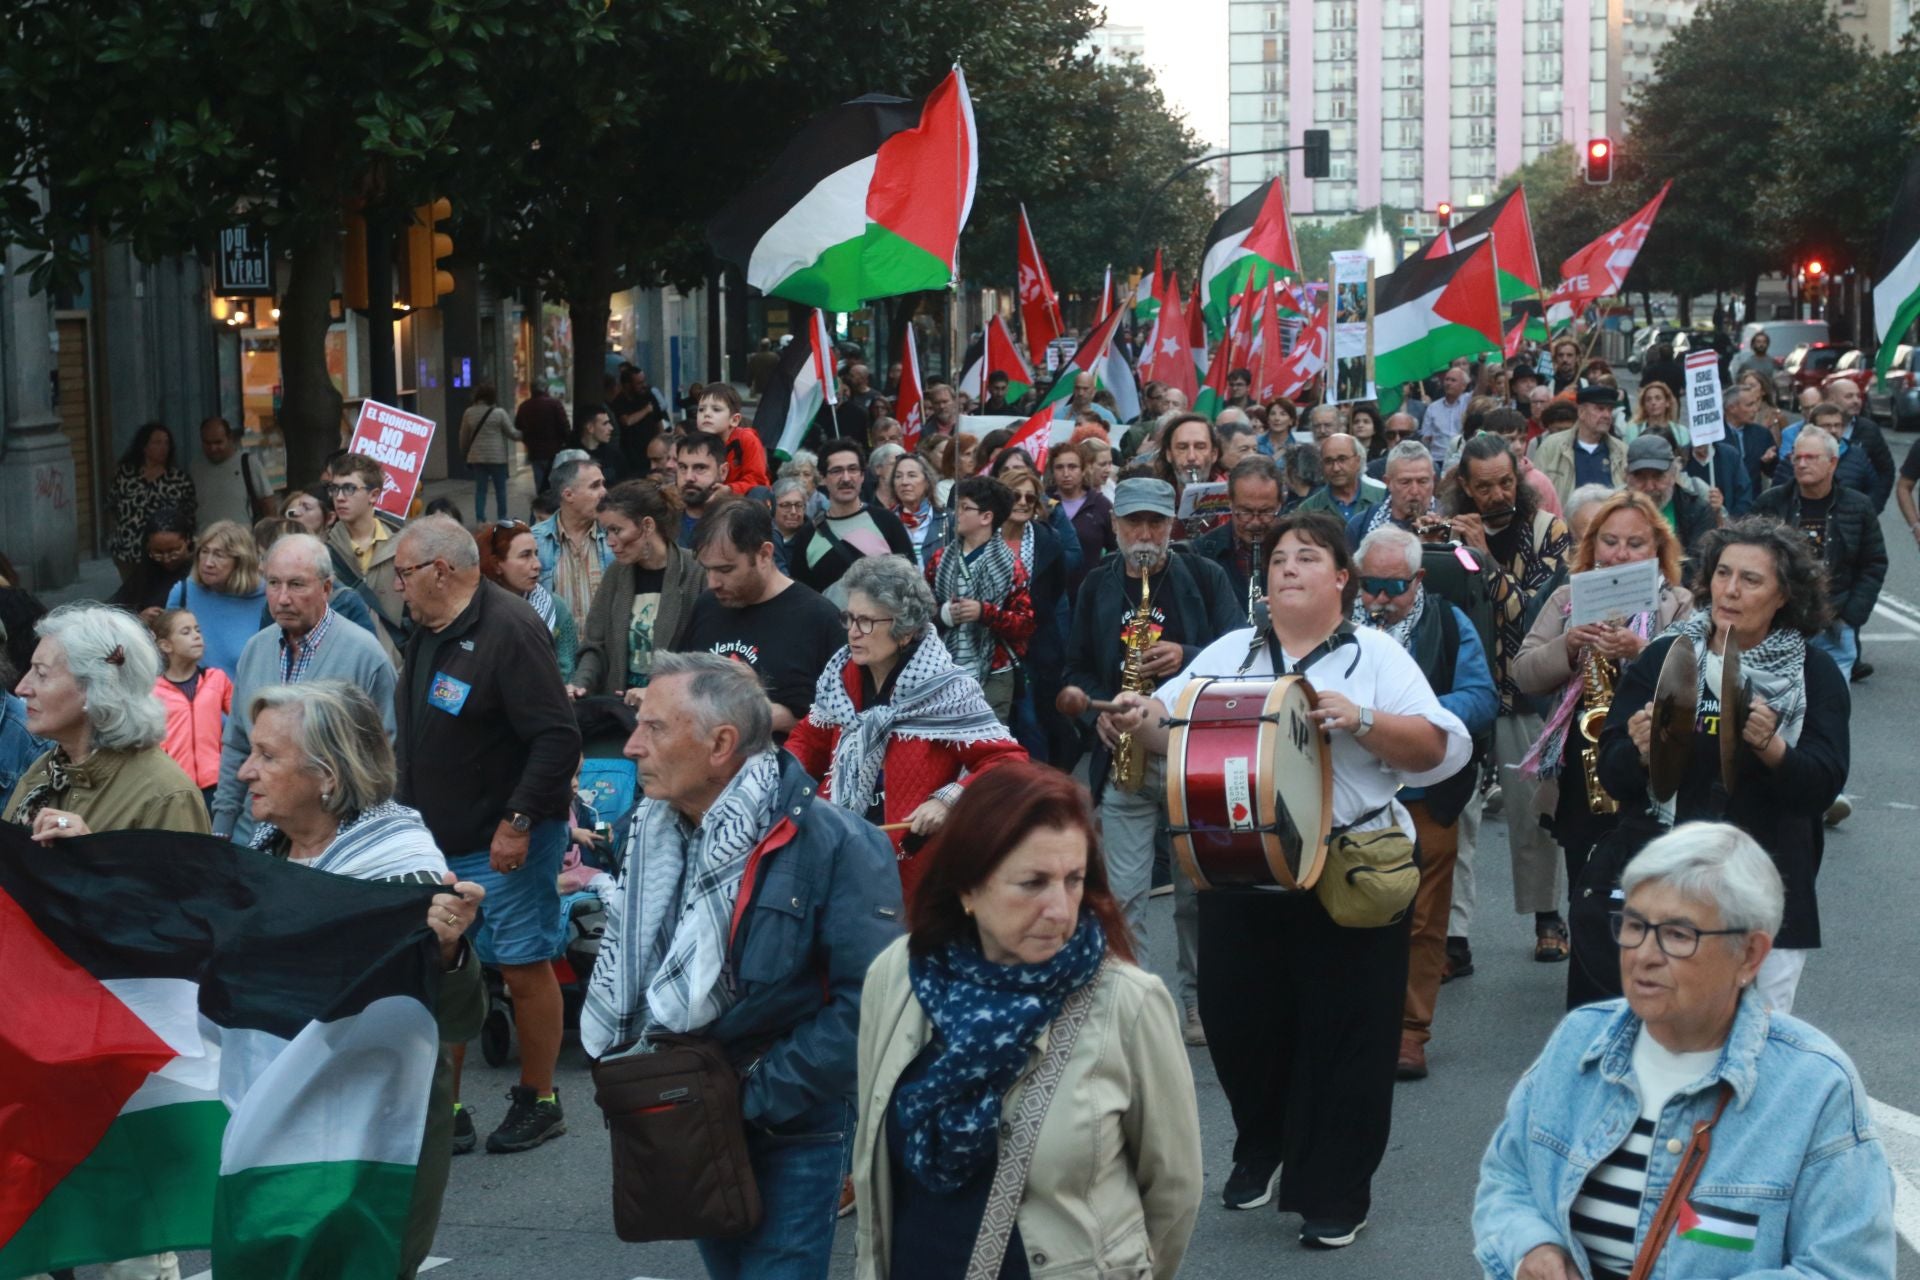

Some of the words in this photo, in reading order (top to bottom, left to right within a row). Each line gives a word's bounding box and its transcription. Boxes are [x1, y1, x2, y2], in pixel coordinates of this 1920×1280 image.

[366, 407, 377, 420] EL
[378, 411, 428, 437] SIONISMO
[379, 426, 403, 448] NO
[709, 640, 758, 664] Ventolin
